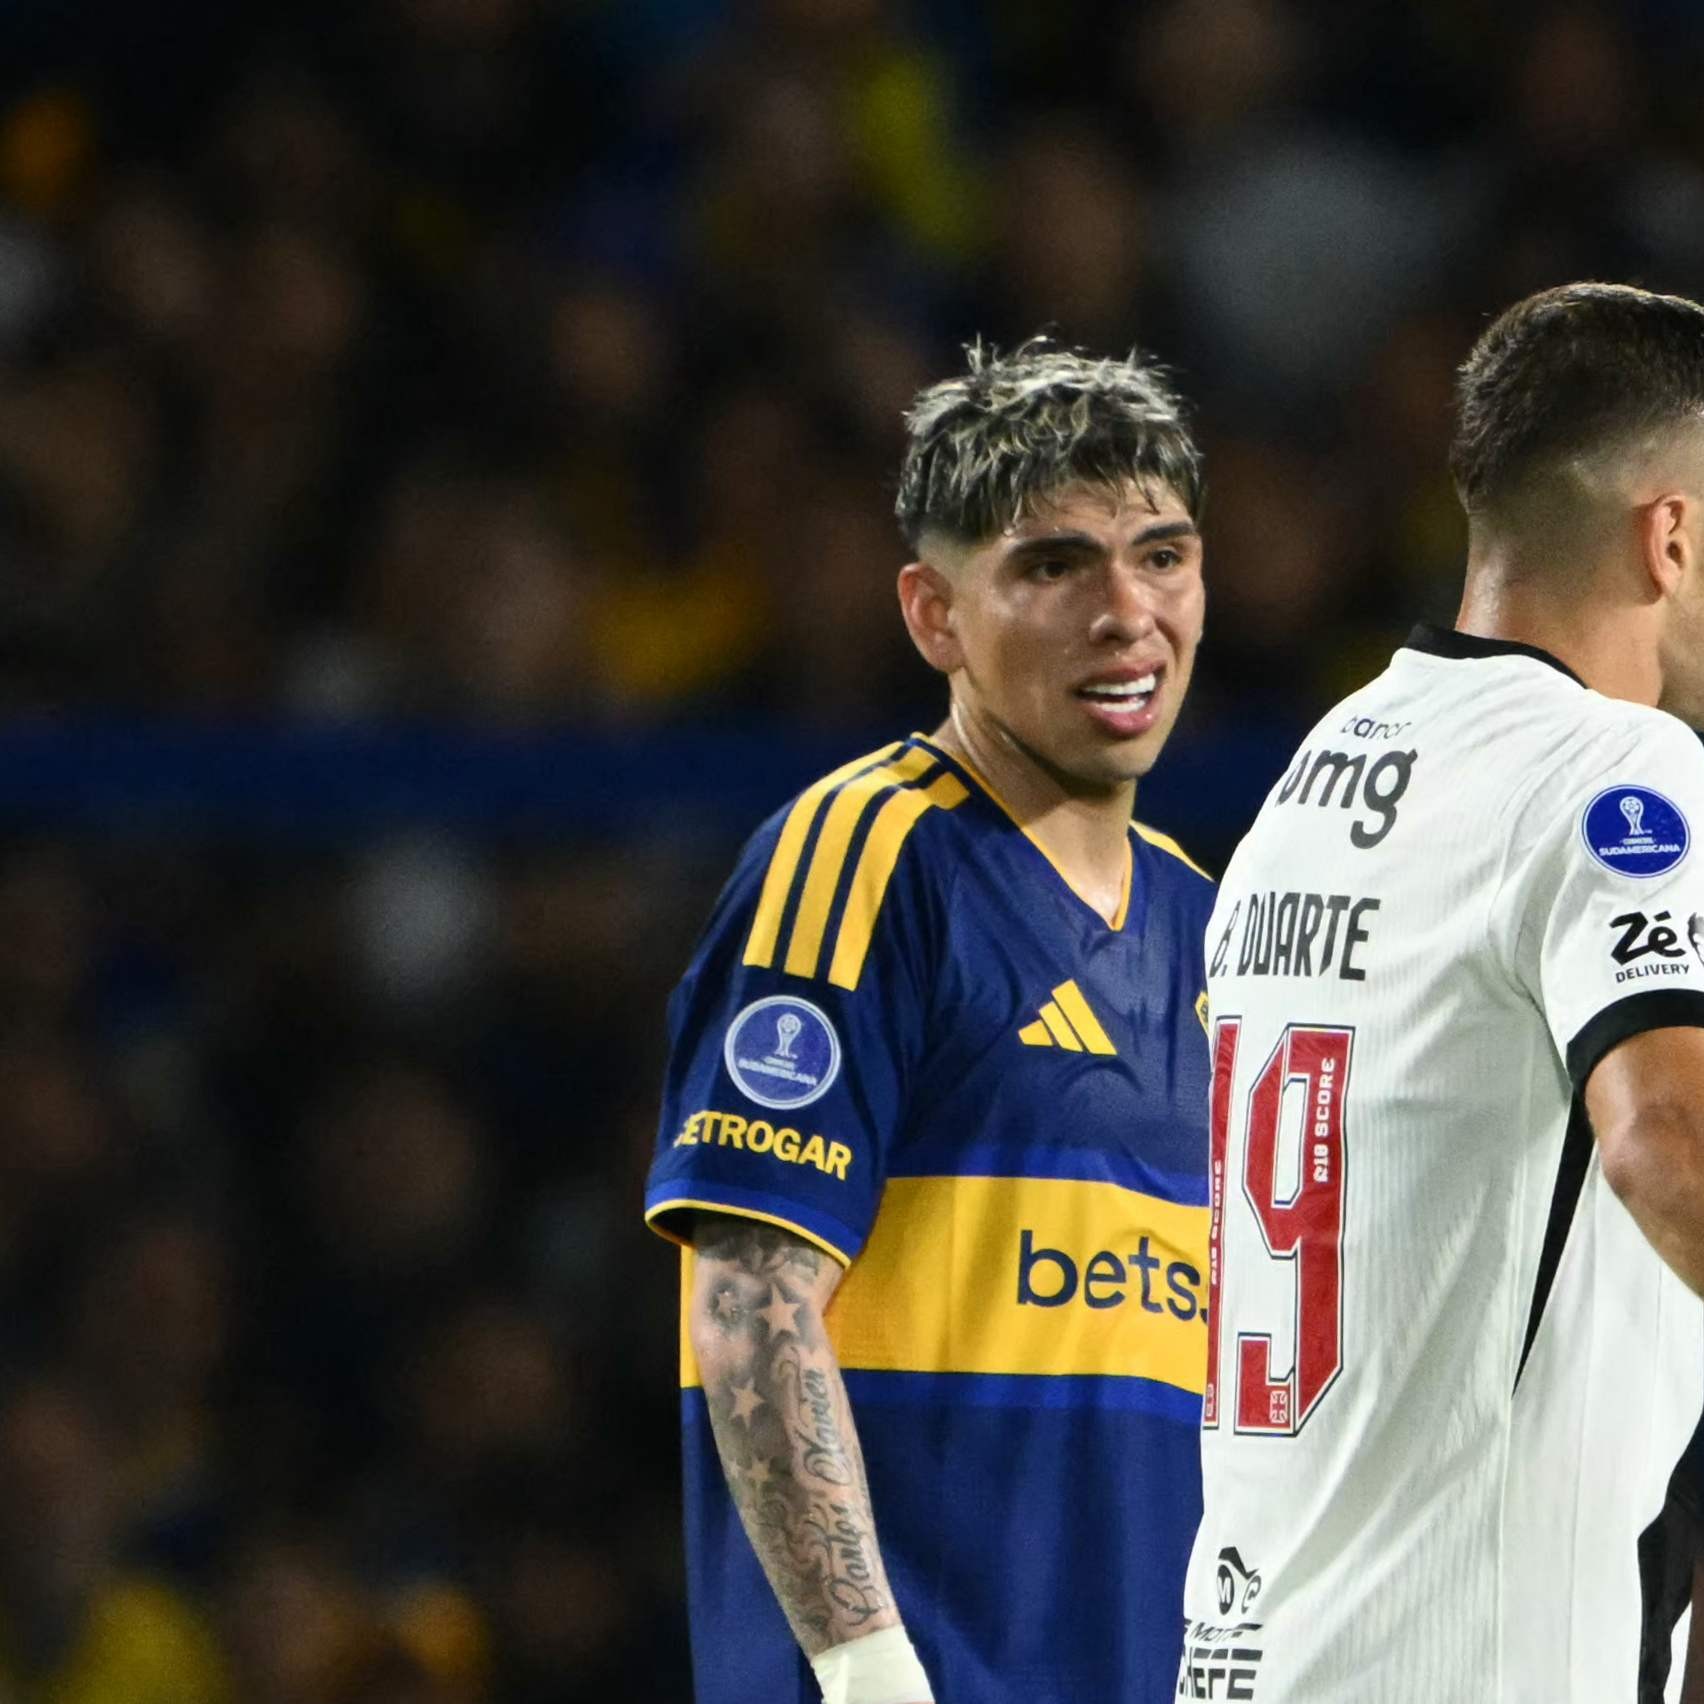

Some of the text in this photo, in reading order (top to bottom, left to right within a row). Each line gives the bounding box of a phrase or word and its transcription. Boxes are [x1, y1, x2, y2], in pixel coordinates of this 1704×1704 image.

[1237, 891, 1381, 981] DUARTE
[1609, 910, 1686, 965] Zé
[1615, 964, 1690, 984] DELIVERY
[1314, 1057, 1336, 1136] SCORE
[1203, 1015, 1356, 1437] 19
[1018, 1229, 1208, 1325] bets
